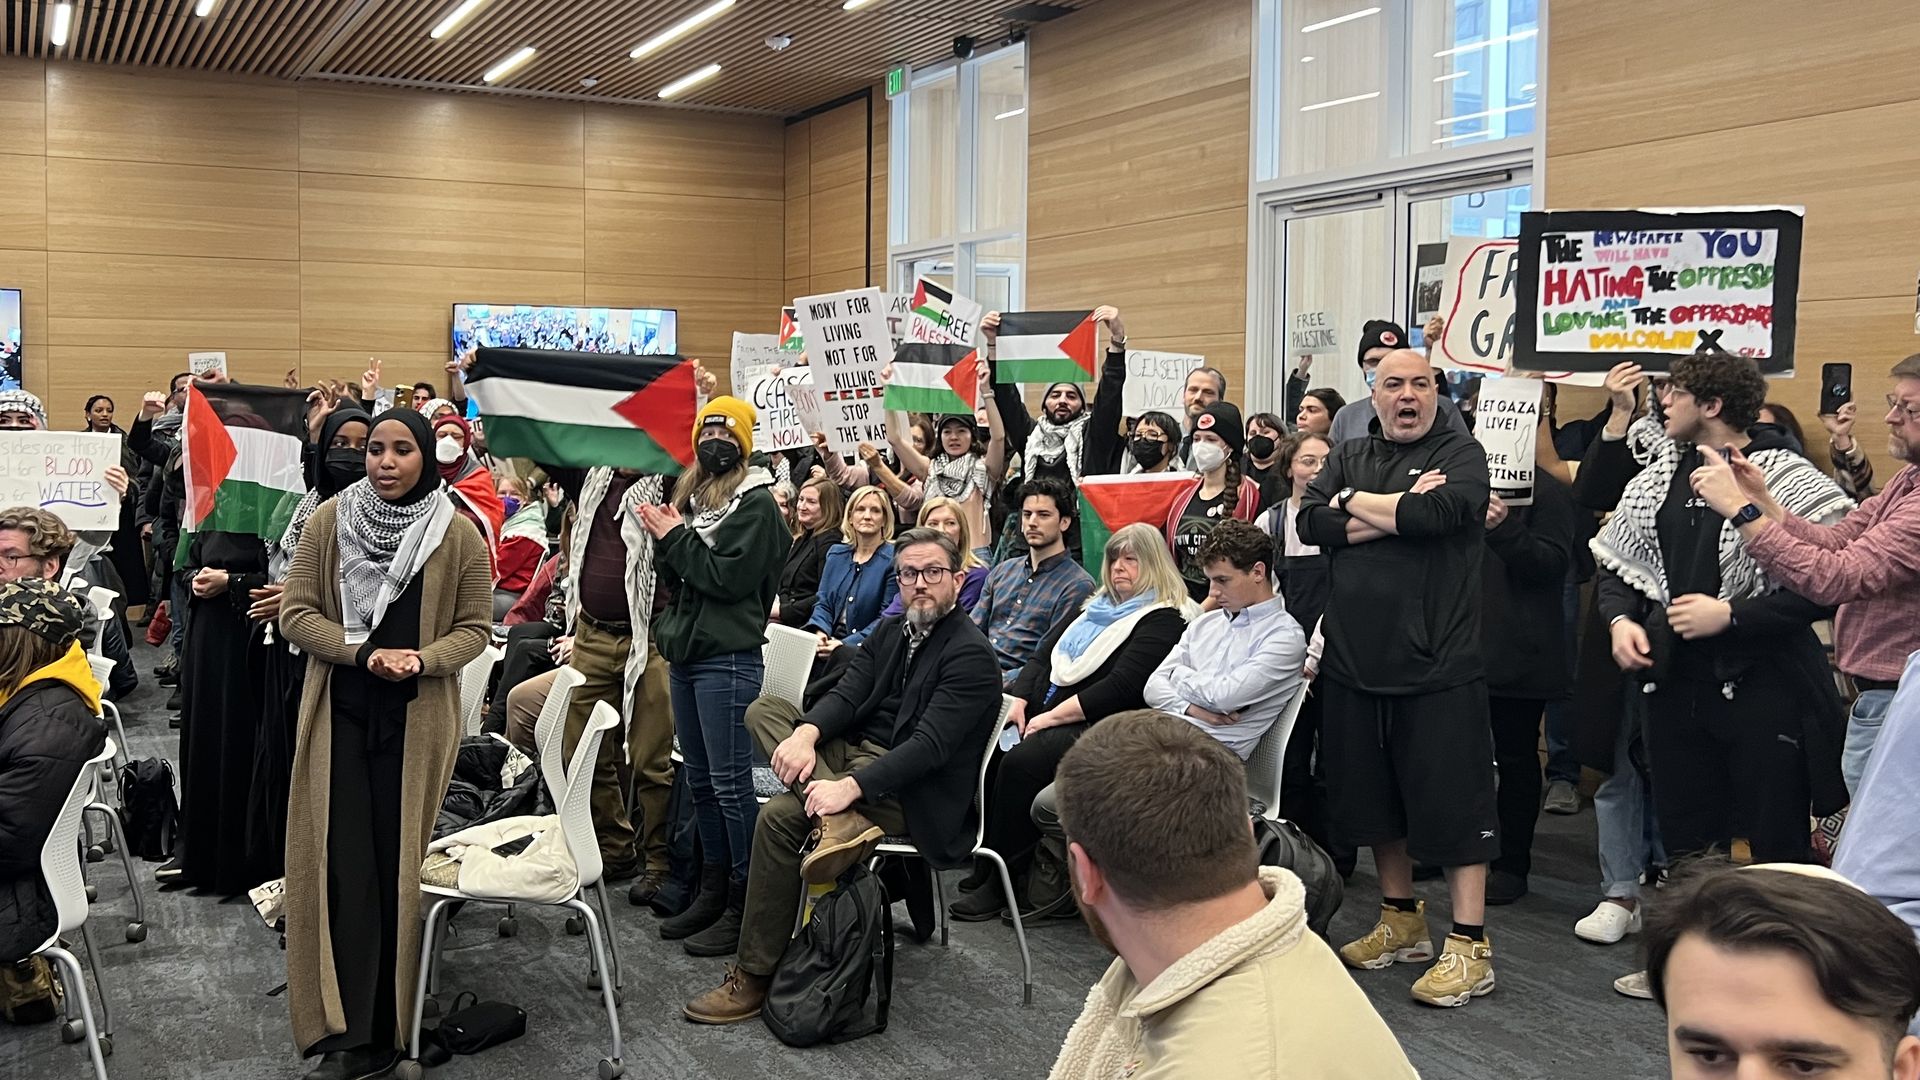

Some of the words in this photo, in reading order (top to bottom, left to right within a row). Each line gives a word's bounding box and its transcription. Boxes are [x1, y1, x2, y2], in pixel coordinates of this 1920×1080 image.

[889, 68, 902, 95] EXIT
[1541, 234, 1583, 263] THE
[1593, 230, 1683, 247] NEWSPAPER
[1698, 229, 1762, 258] YOU
[1595, 250, 1631, 262] WILL
[1479, 249, 1519, 299] FR
[1543, 265, 1644, 306] HATING
[1645, 265, 1678, 292] THE
[809, 301, 837, 321] MONY
[846, 296, 871, 316] FOR
[1601, 298, 1640, 310] AND
[938, 309, 972, 343] FREE
[1296, 311, 1325, 329] FREE
[1543, 311, 1627, 335] LOVING
[1631, 307, 1666, 325] THE
[823, 322, 861, 342] LIVING
[911, 317, 956, 345] PALEST
[1292, 329, 1336, 349] PALESTINE
[1470, 309, 1516, 360] GA
[1694, 328, 1723, 354] X
[825, 348, 846, 366] NOT
[853, 345, 877, 363] FOR
[1129, 351, 1202, 380] CEASEFIR
[834, 370, 876, 389] KILLING
[1142, 383, 1185, 407] NOW
[841, 403, 869, 421] STOP
[1478, 400, 1494, 412] LET
[1498, 400, 1536, 414] GAZA
[770, 408, 800, 429] FIRE
[1486, 417, 1517, 431] LIVE!
[773, 428, 803, 448] NOW
[836, 426, 860, 443] THE
[864, 423, 887, 441] WAR
[45, 456, 93, 477] BLOOD
[1486, 453, 1508, 465] REE
[1488, 468, 1532, 481] STINE!
[37, 481, 103, 501] WATER
